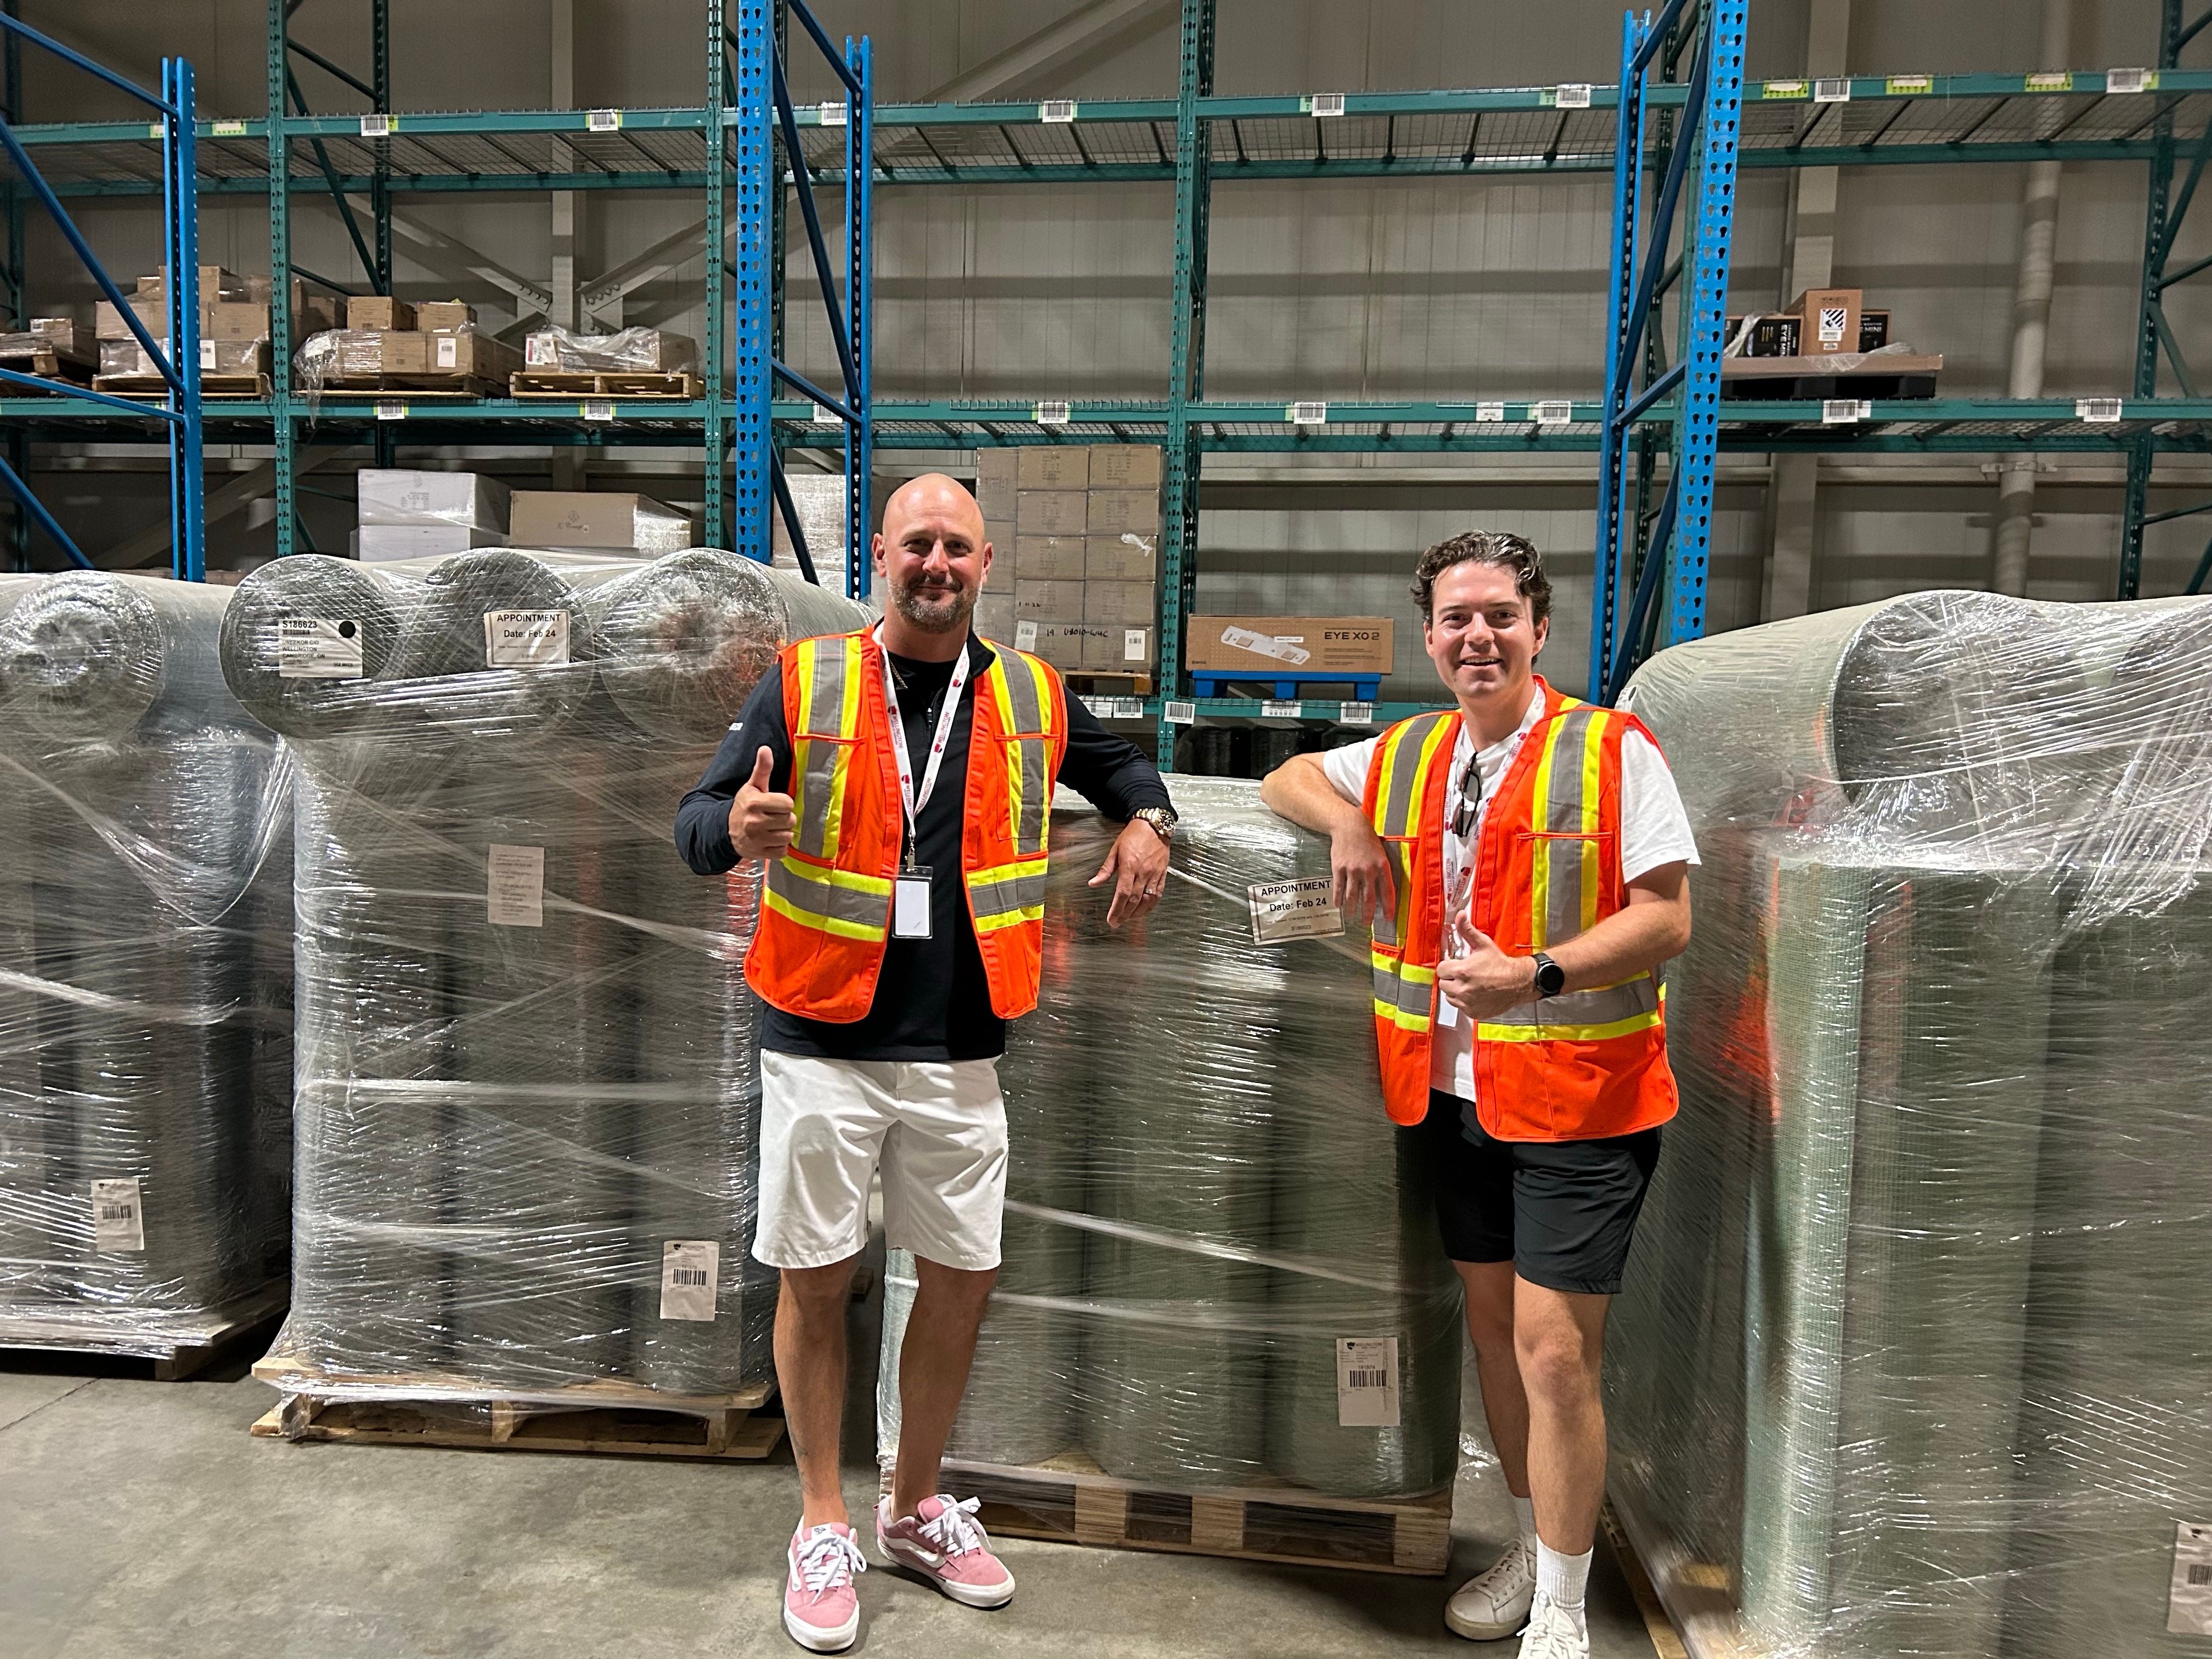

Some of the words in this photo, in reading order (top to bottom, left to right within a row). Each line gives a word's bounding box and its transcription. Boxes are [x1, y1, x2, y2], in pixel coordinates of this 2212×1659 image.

[497, 614, 561, 622] APPOINTMENT
[893, 714, 904, 748] WELLINGTON
[938, 712, 949, 743] WELLINGTON
[1504, 741, 1522, 772] WELLINGTON
[1261, 880, 1331, 896] APPOINTMENT
[1453, 878, 1467, 907] WELLINGTON
[1269, 902, 1294, 912] Date:
[1296, 899, 1313, 908] Feb
[1316, 897, 1327, 906] 24
